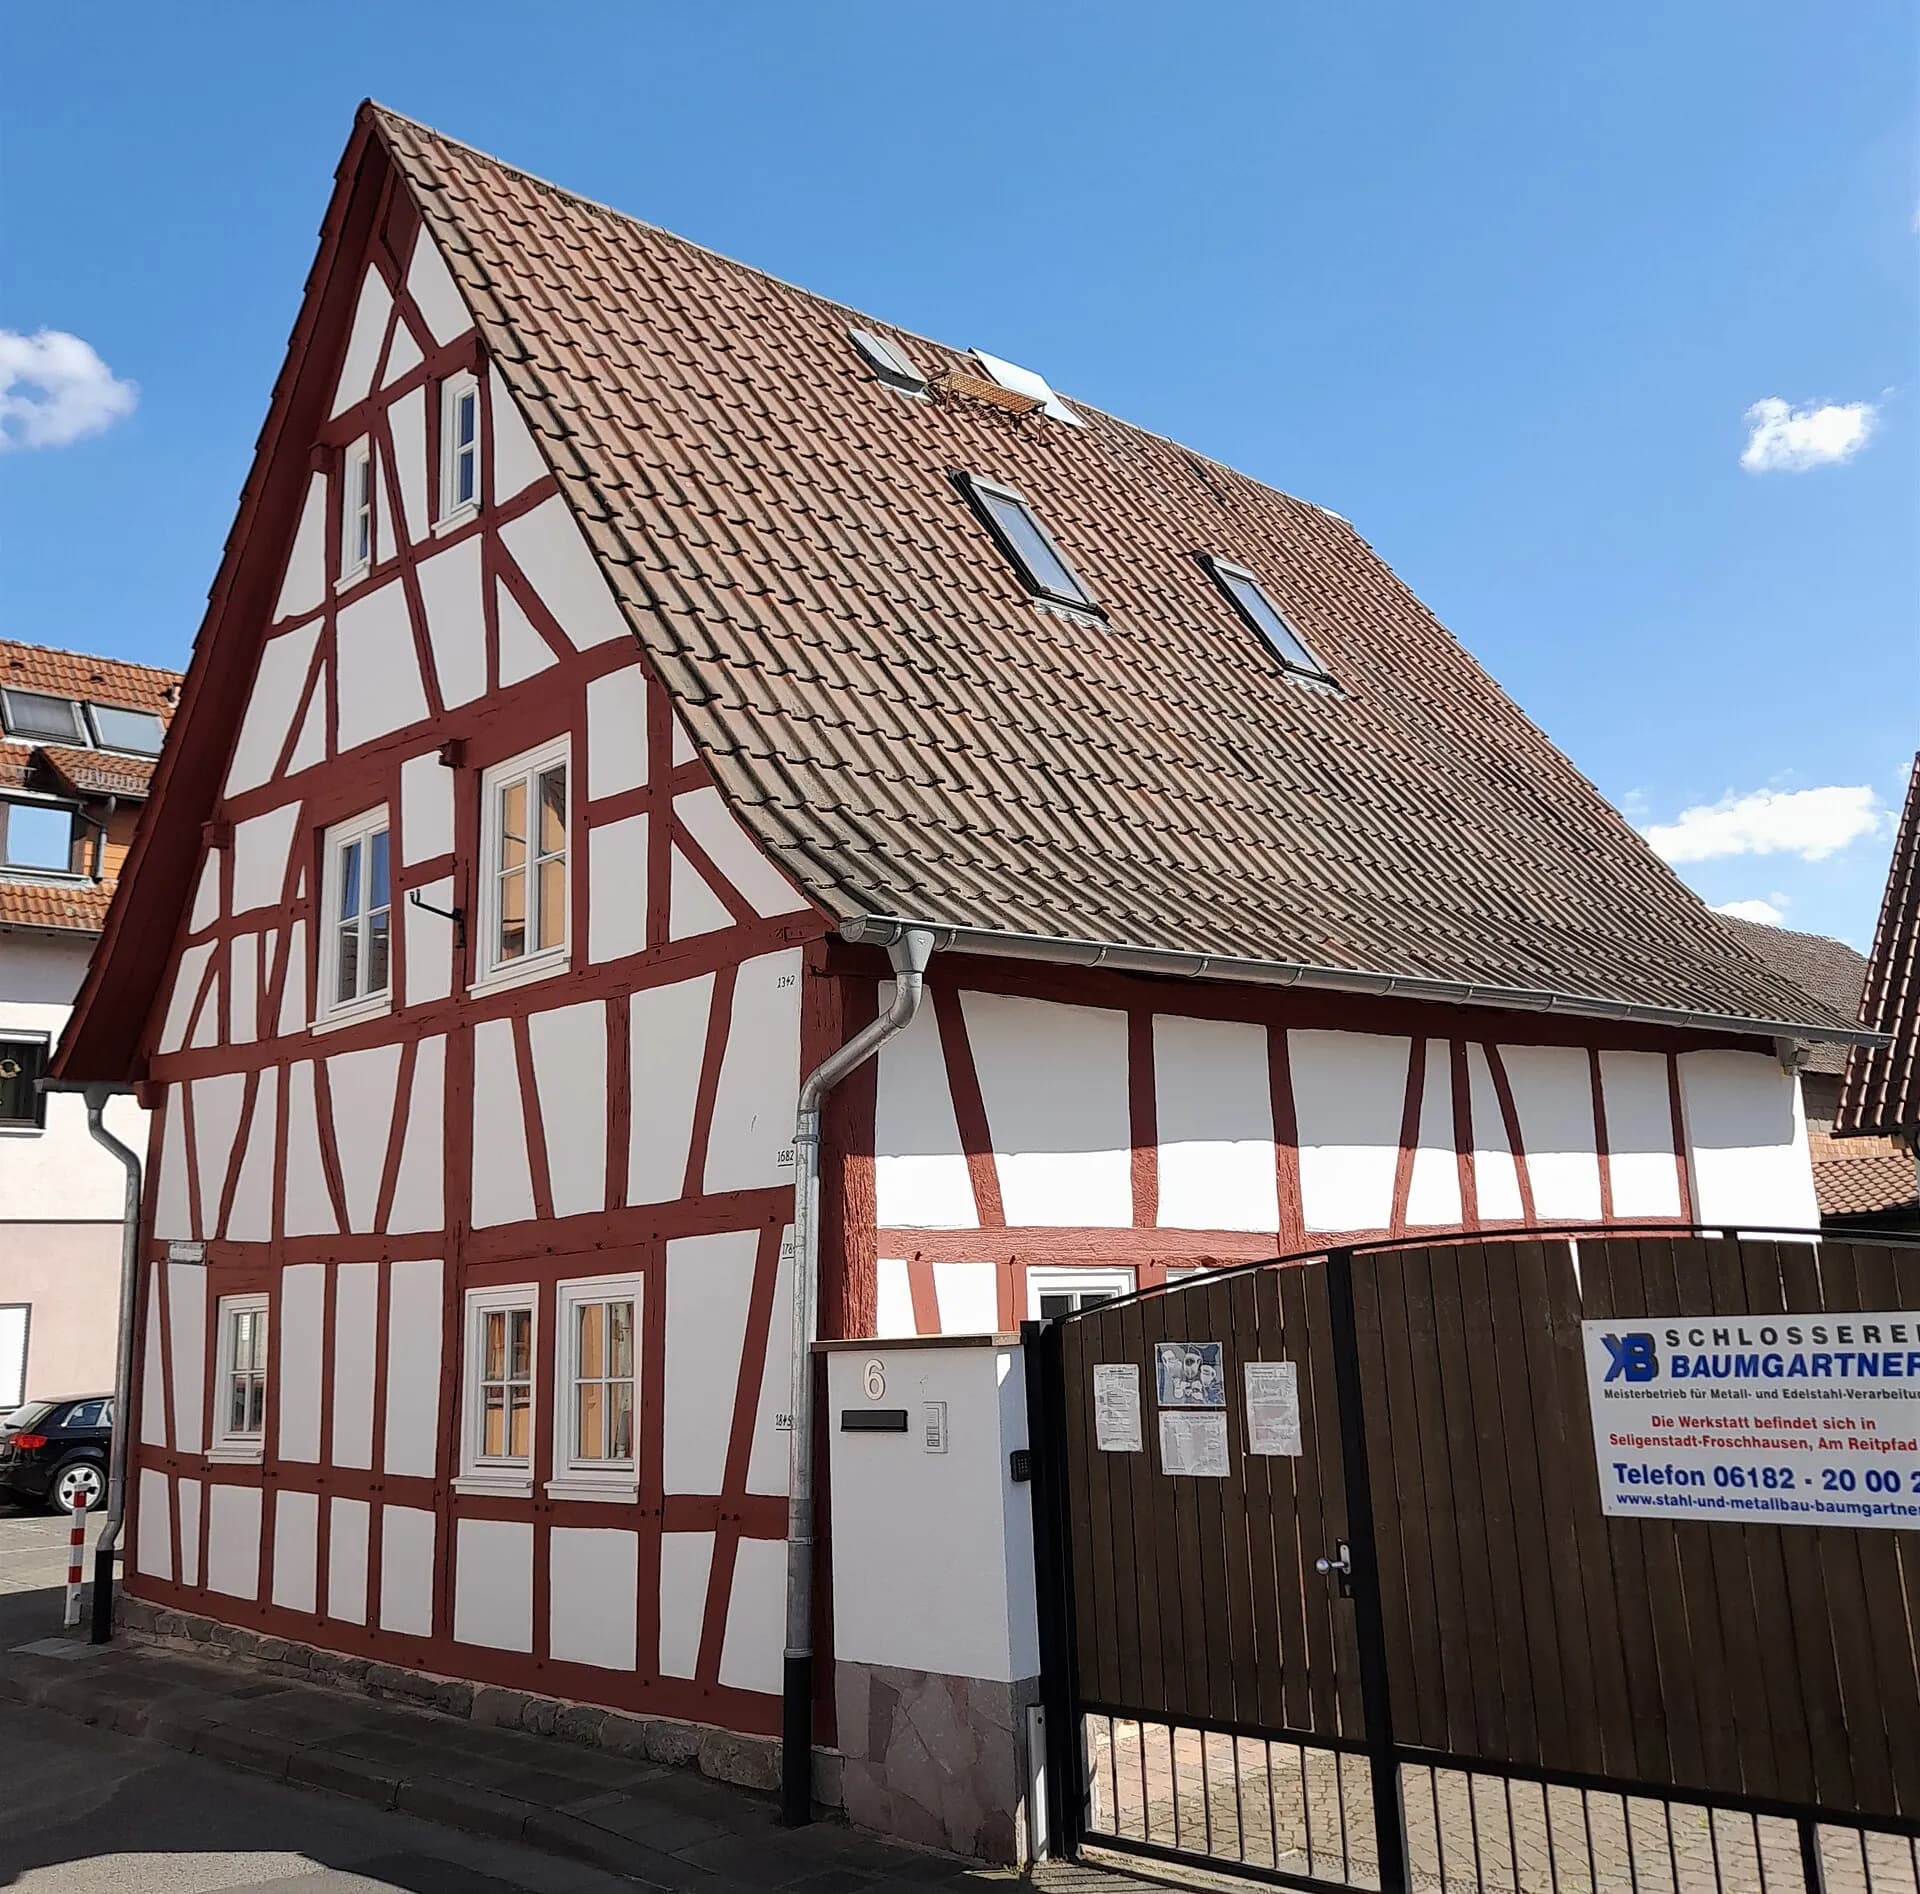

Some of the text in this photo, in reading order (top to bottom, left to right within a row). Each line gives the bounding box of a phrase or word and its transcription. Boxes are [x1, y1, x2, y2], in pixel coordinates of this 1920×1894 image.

[777, 1150, 794, 1162] 1682
[782, 1243, 795, 1255] 178
[1671, 1352, 1920, 1378] BAUMGARTNER
[863, 1359, 886, 1400] 6
[1604, 1388, 1687, 1399] Meisterbetrieb
[1690, 1388, 1707, 1399] für
[1711, 1388, 1752, 1400] Metall-
[1755, 1388, 1779, 1399] und
[1651, 1415, 1876, 1430] Die Werkstatt befindet sich in
[1609, 1433, 1917, 1453] Seligenstadt-Froschhausen, Am Reitpfad
[1613, 1463, 1706, 1486] Telefon
[1713, 1465, 1795, 1489] 06182
[1821, 1468, 1856, 1491] 20
[1865, 1470, 1901, 1493] 00
[1616, 1493, 1920, 1517] www.stahl-und-metallbau-baumgartne
